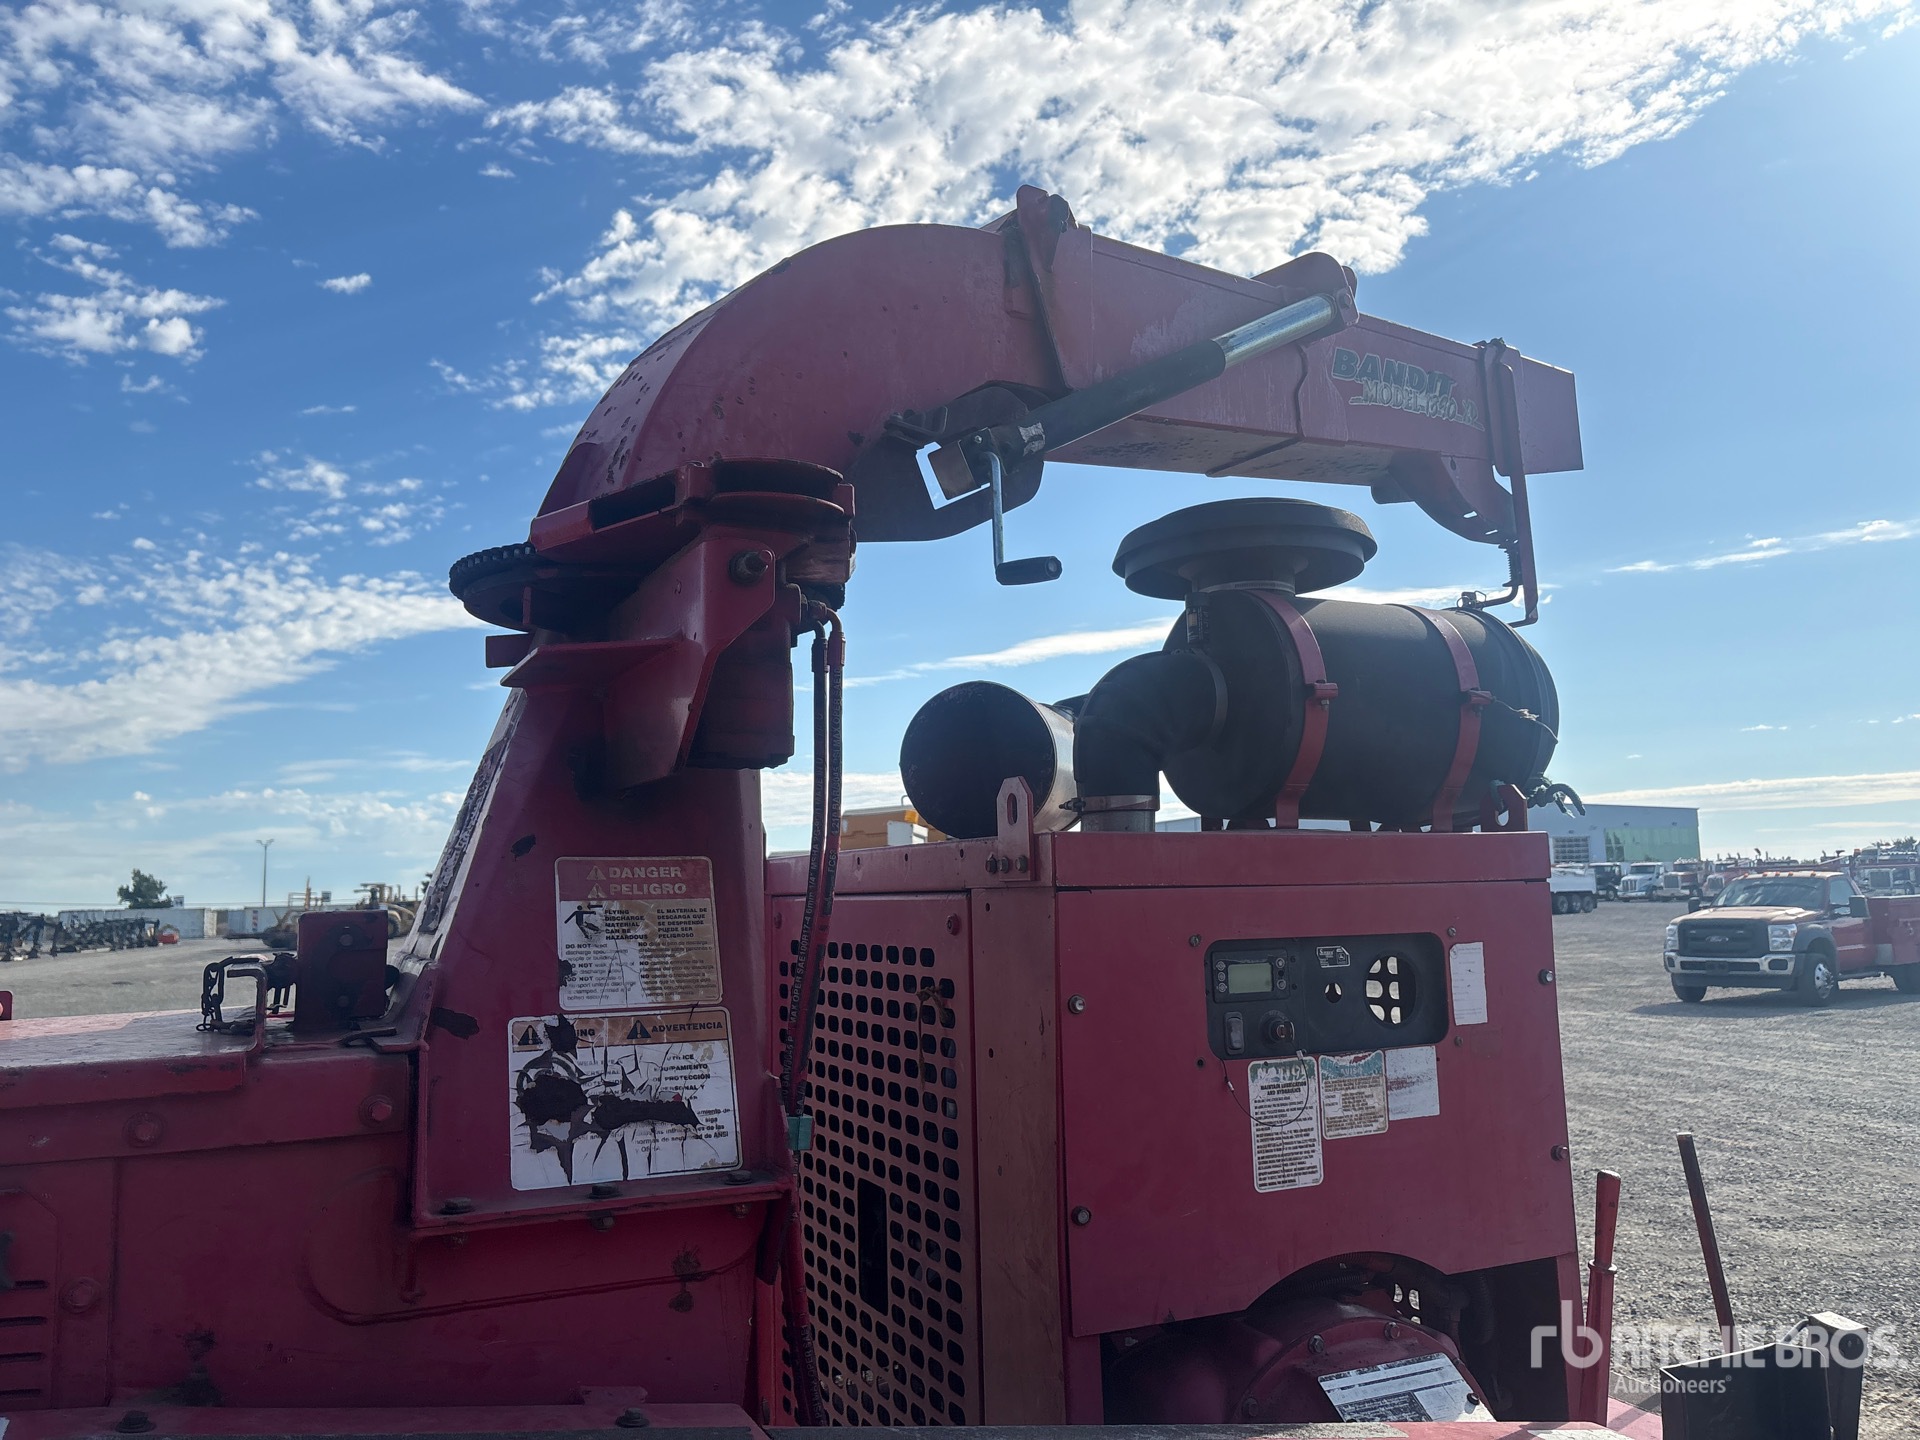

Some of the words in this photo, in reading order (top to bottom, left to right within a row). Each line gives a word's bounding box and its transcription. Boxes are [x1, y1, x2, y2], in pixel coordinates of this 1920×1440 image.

[1332, 347, 1457, 396] BANDIT
[1363, 380, 1421, 413] MODEL
[608, 866, 682, 878] DANGER
[609, 882, 687, 895] PELIGRO
[792, 976, 803, 1002] OPER
[651, 1021, 723, 1033] ADVERTENCIA
[664, 1073, 711, 1081] PROTECCIÓN
[804, 1349, 816, 1377] OPER
